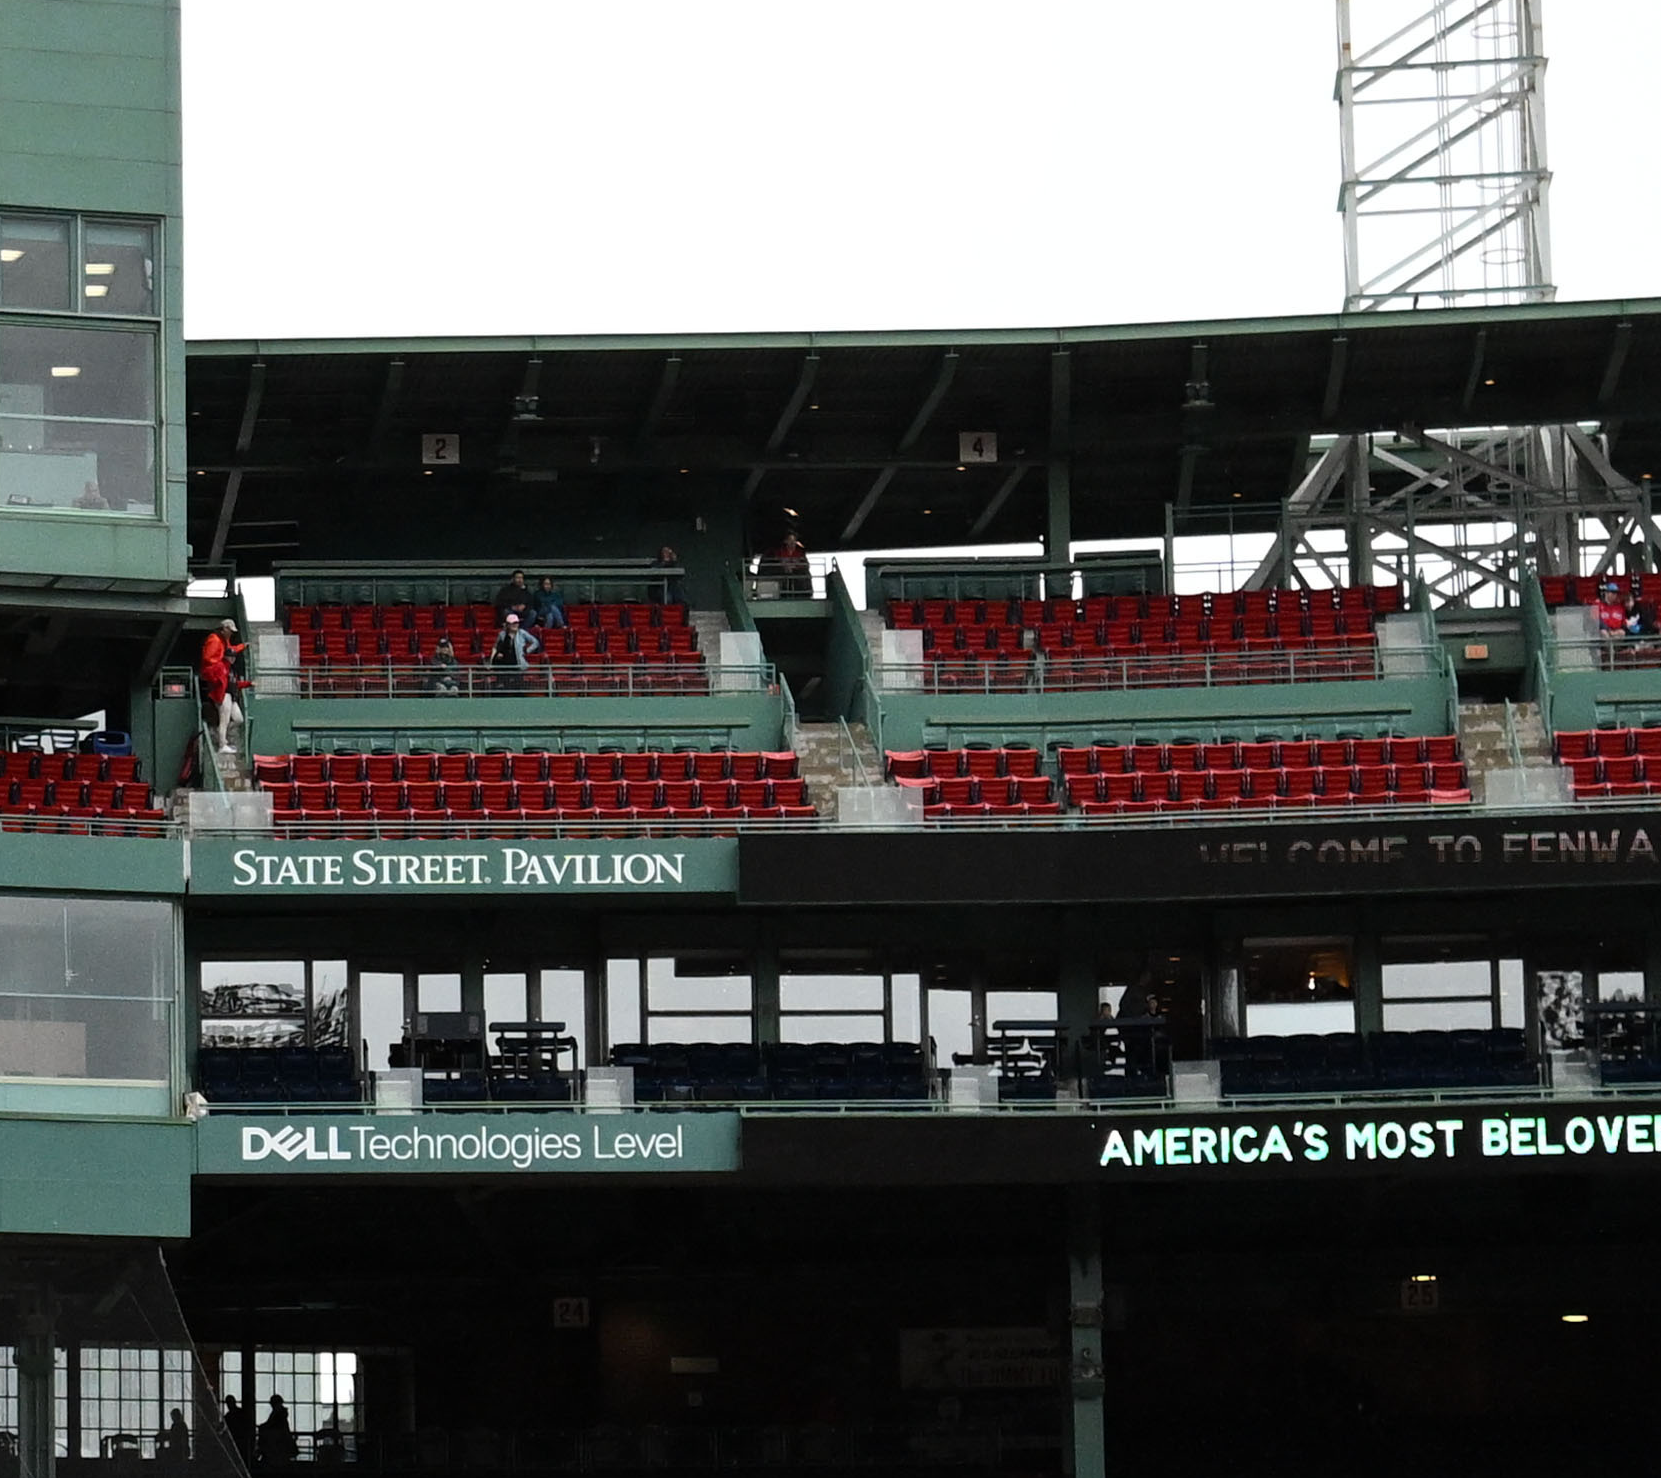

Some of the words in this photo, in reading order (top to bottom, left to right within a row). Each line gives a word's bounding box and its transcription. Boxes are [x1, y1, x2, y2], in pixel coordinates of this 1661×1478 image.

[435, 438, 446, 460] 2
[973, 437, 983, 457] 4
[233, 850, 344, 886] STATE
[353, 850, 488, 886] STREET
[502, 848, 684, 885] PAVILION
[242, 1125, 351, 1162] DELL
[350, 1125, 581, 1169] Technologies
[594, 1125, 683, 1159] Level
[1101, 1125, 1329, 1166] AMERICA'S
[1344, 1120, 1463, 1160] MOST
[559, 1302, 584, 1323] 24
